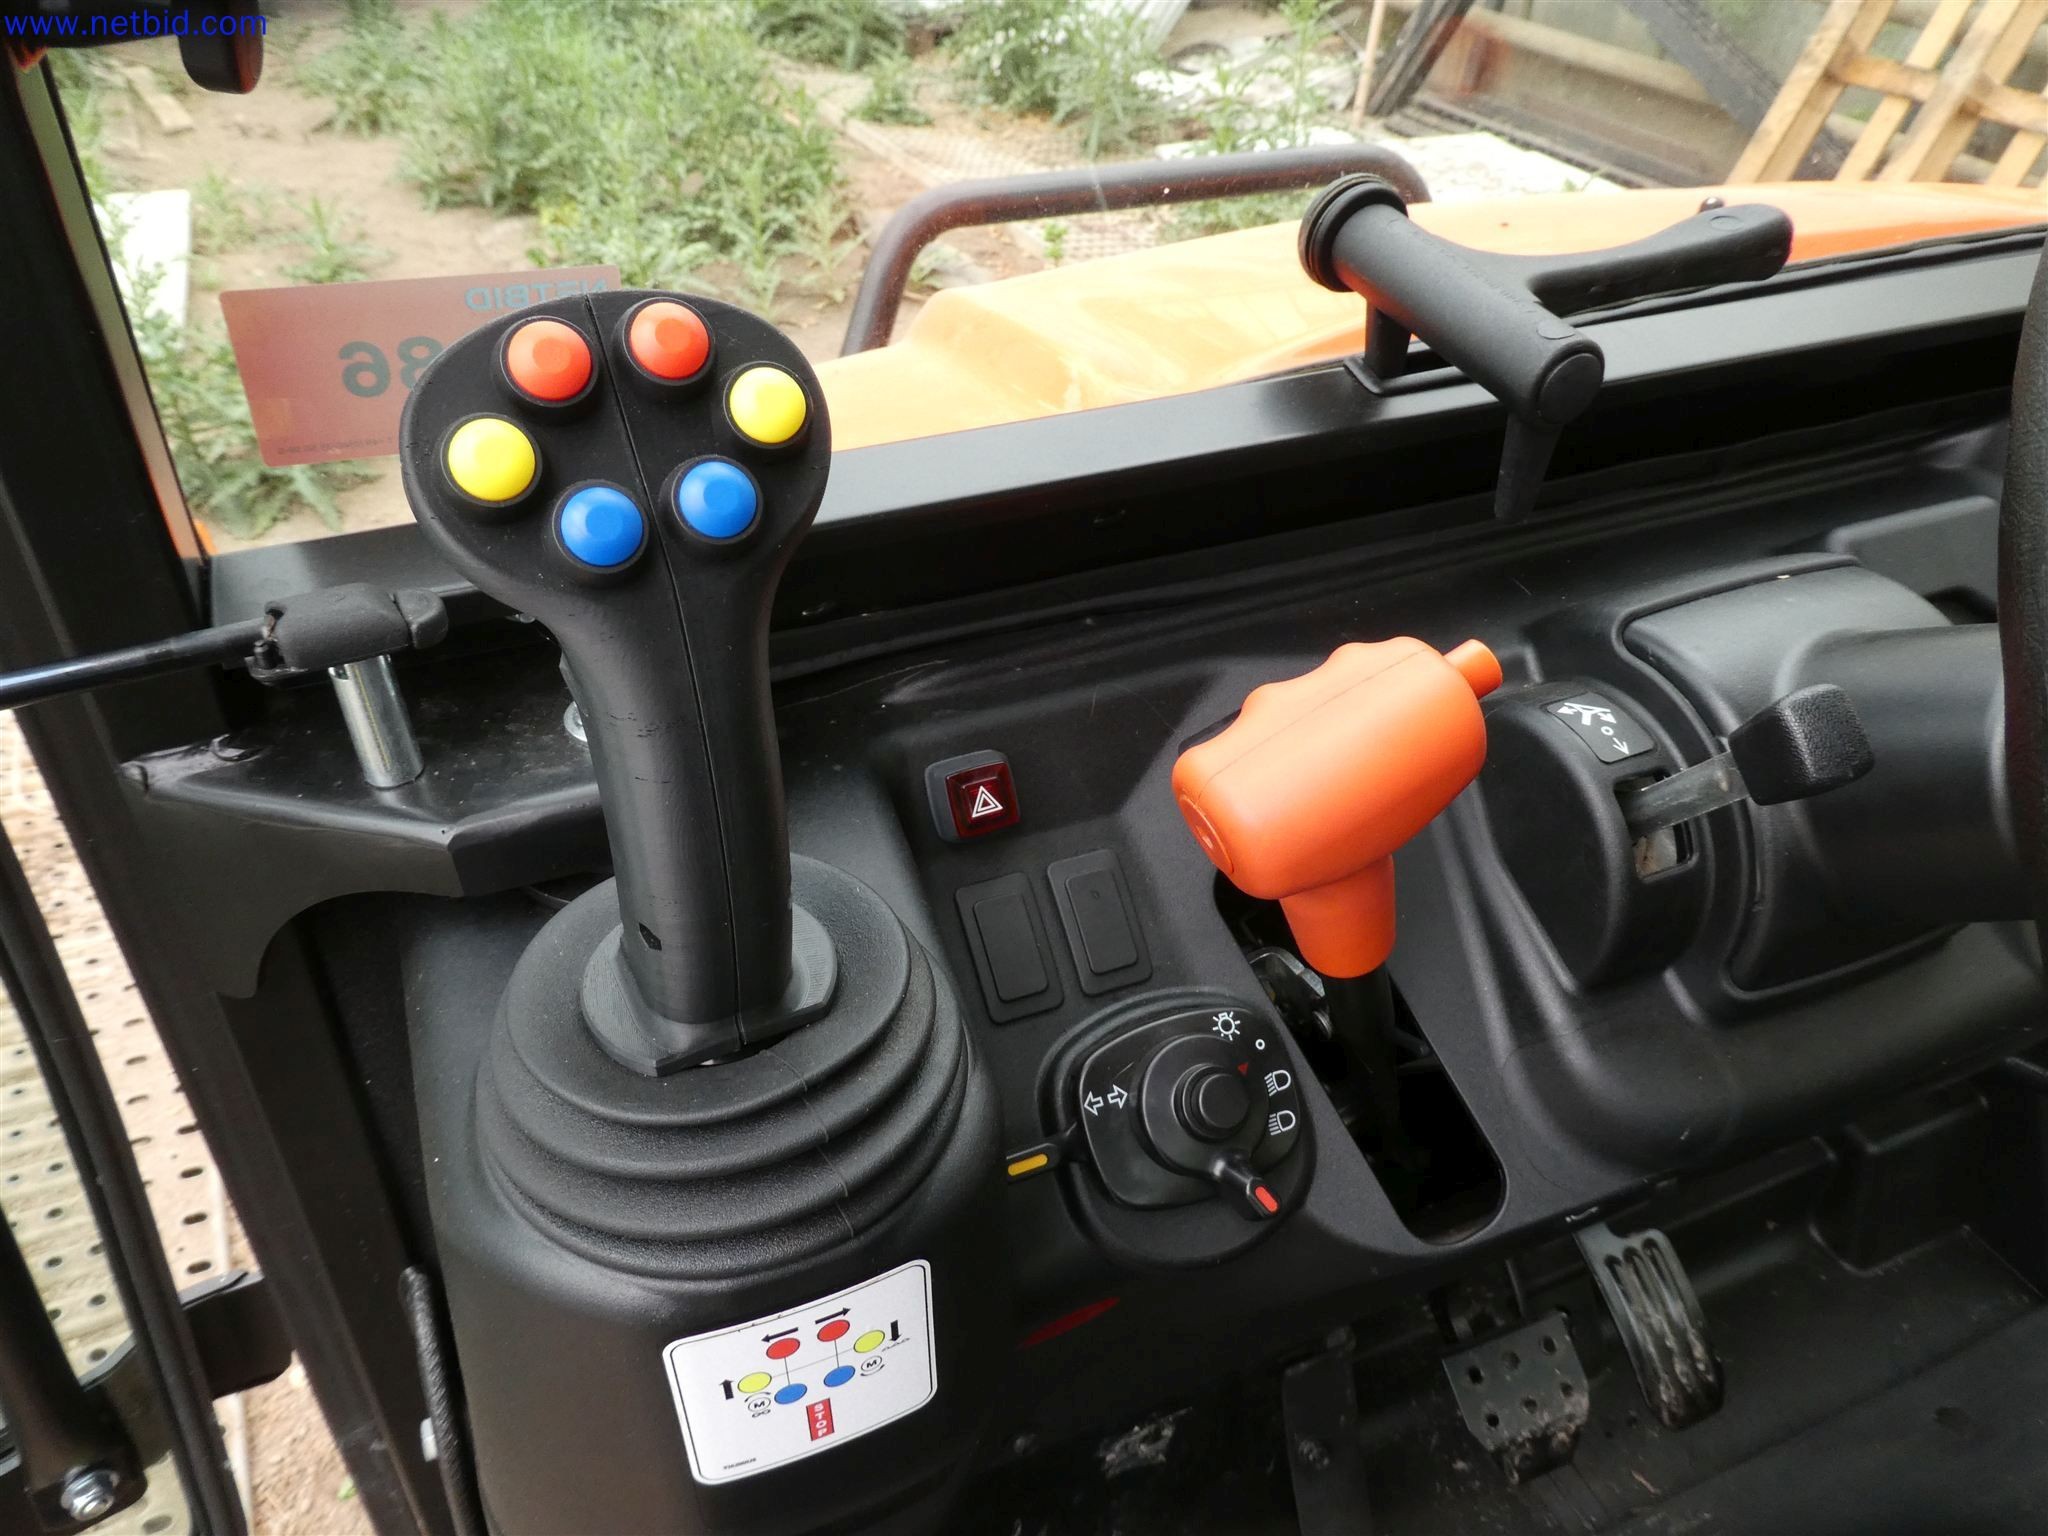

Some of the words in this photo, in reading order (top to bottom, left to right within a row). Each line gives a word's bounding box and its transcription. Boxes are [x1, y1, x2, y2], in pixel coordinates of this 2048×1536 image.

[866, 1359, 877, 1369] M
[753, 1400, 766, 1409] M
[813, 1402, 828, 1437] STOP
